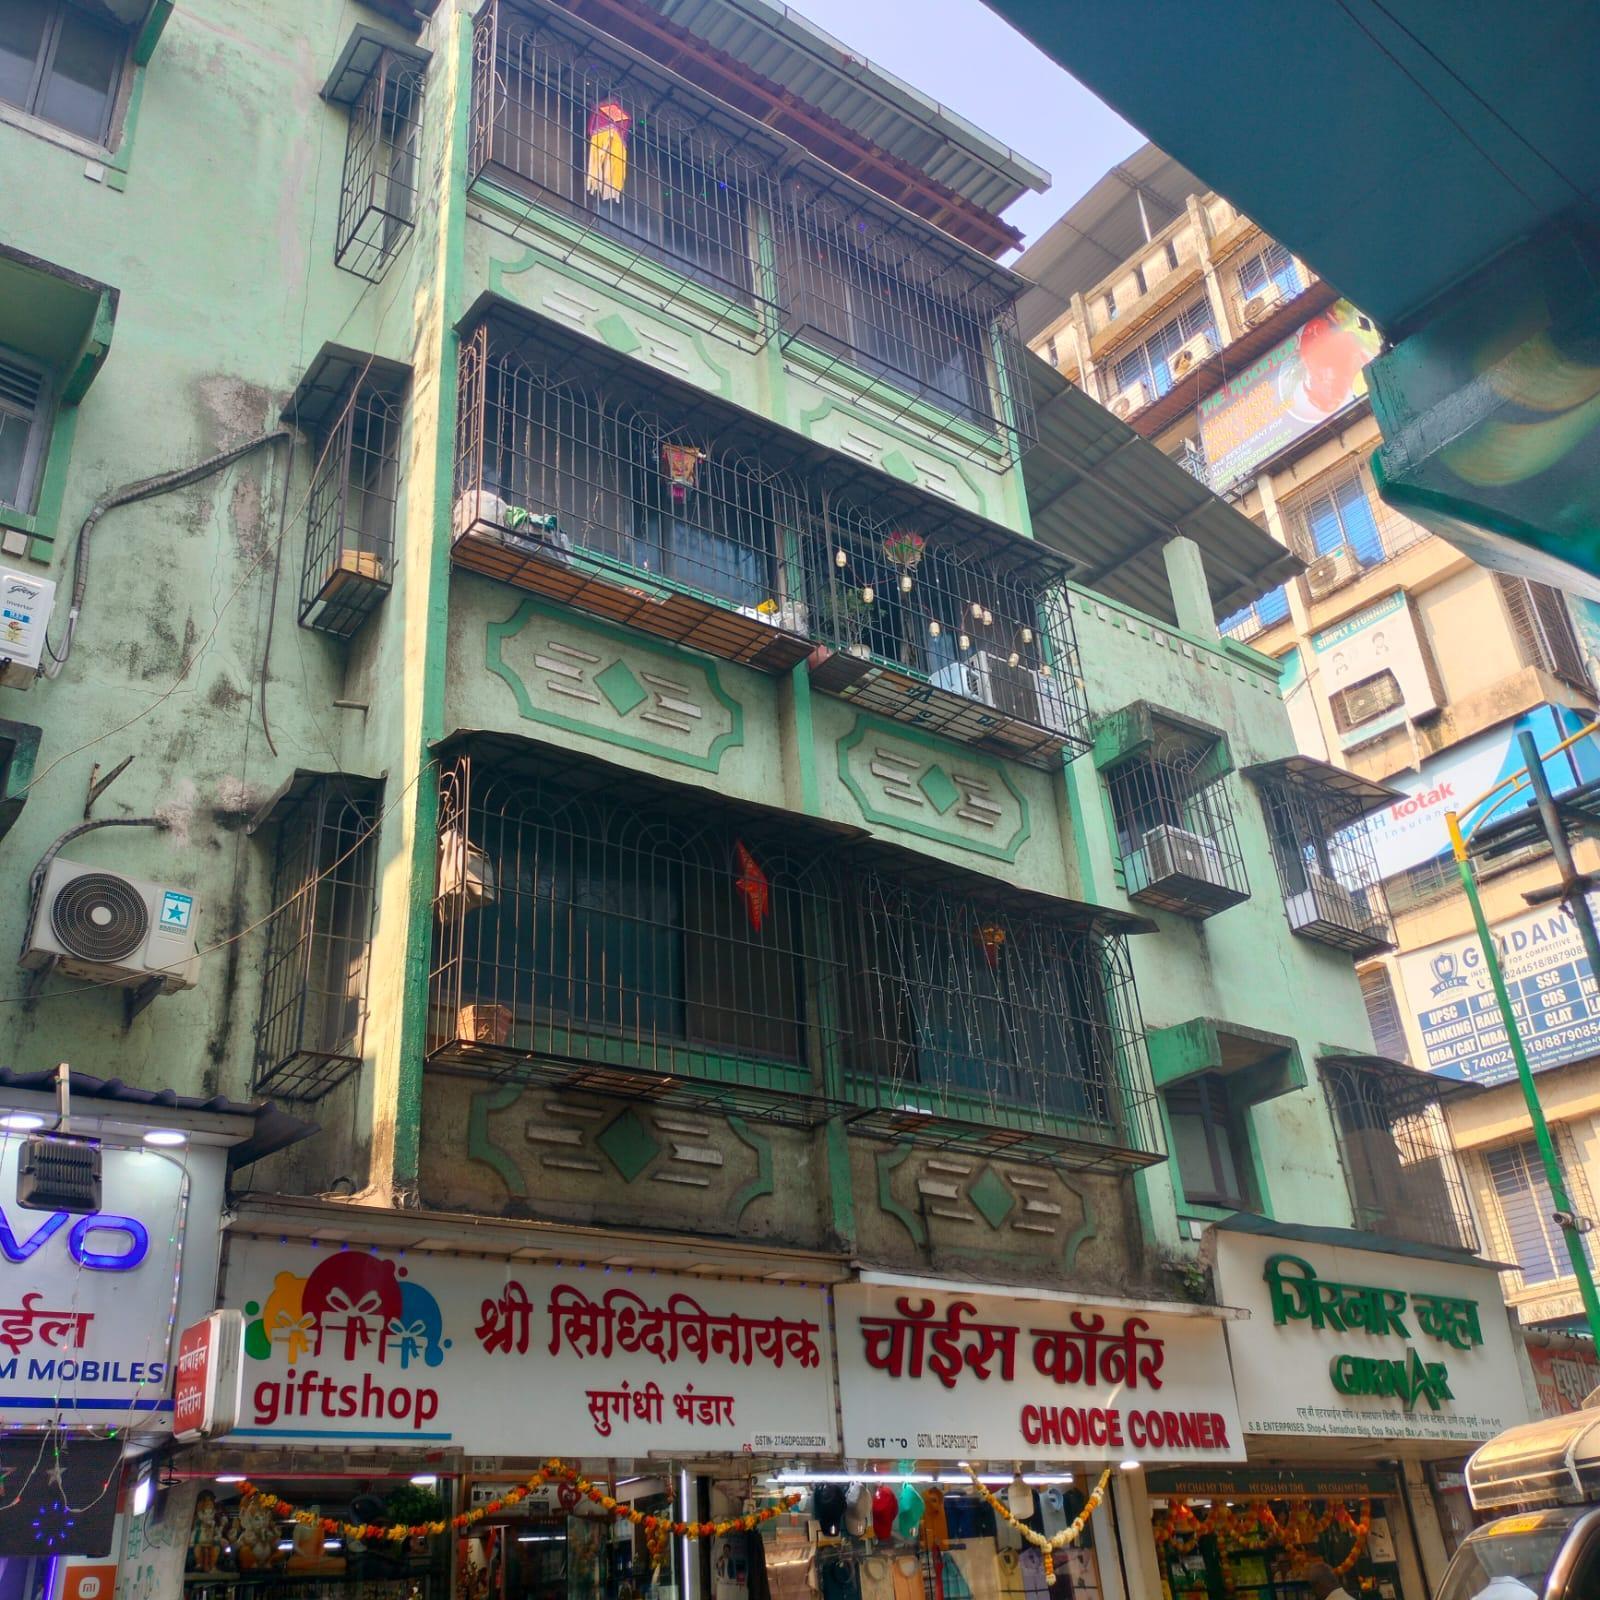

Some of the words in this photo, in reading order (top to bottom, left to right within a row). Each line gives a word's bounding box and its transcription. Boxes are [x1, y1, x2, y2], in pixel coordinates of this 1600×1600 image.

[1391, 782, 1456, 822] kotak
[1535, 969, 1560, 989] SSC
[1428, 1004, 1459, 1025] UPSC
[1544, 1006, 1574, 1028] CLAT
[1424, 1019, 1472, 1046] BANKING
[1429, 1038, 1476, 1065] MBA/CAT
[474, 1280, 533, 1354] श्री
[860, 1297, 1020, 1389] चॉईस
[1030, 1310, 1165, 1390] कॉर्नर
[28, 1358, 165, 1384] MOBILES
[1329, 1346, 1456, 1412] GIRNAR
[252, 1368, 439, 1430] giftshop
[584, 1381, 664, 1436] सुगंधी
[673, 1383, 735, 1427] भंडार
[1021, 1404, 1124, 1448] CHOICE
[1128, 1408, 1231, 1449] CORNER
[867, 1438, 886, 1449] GST
